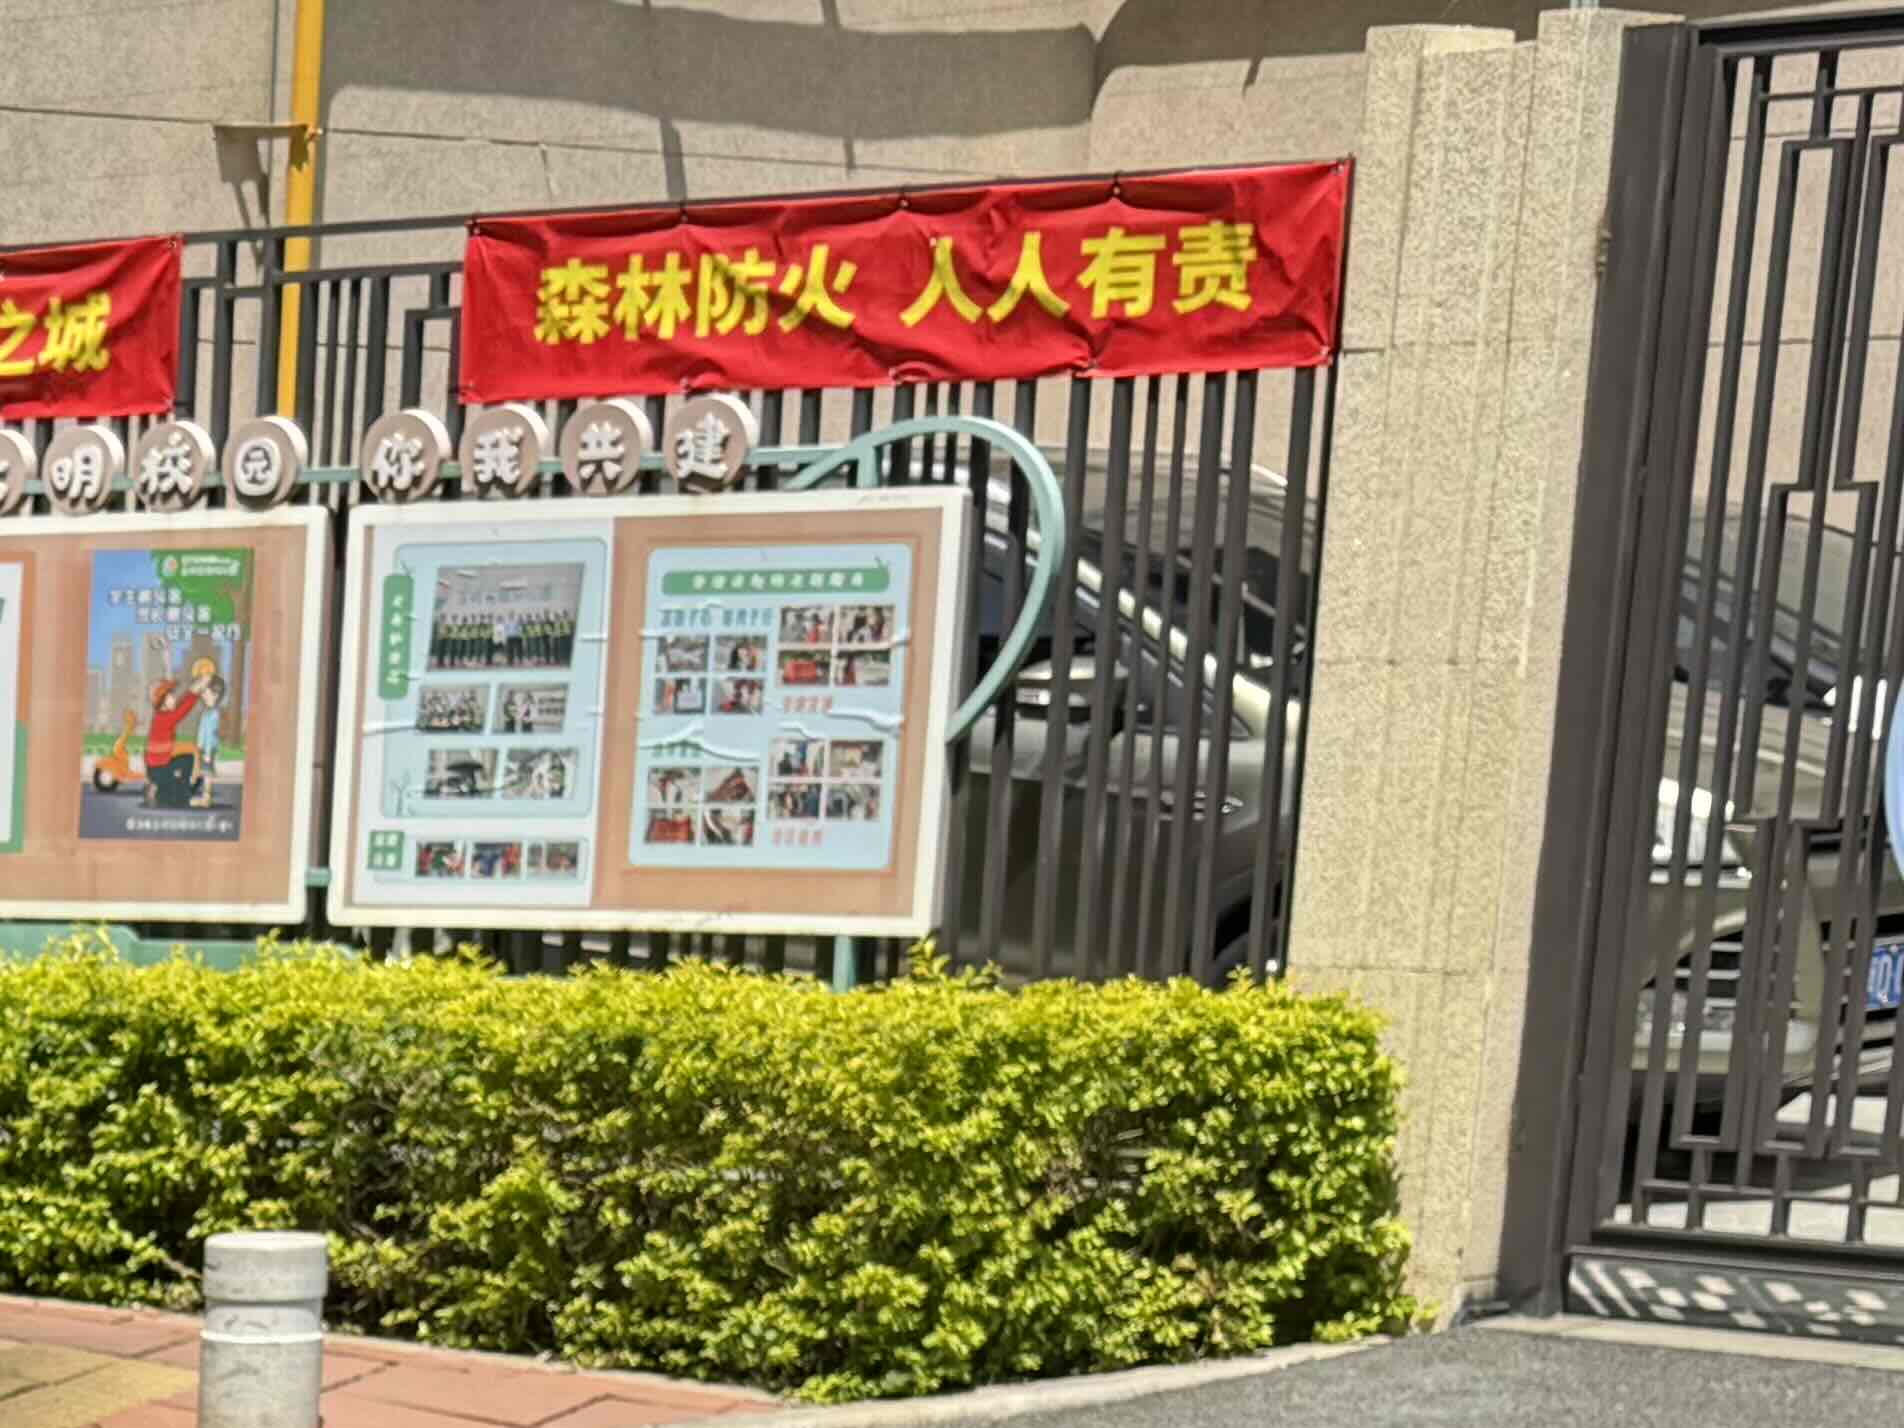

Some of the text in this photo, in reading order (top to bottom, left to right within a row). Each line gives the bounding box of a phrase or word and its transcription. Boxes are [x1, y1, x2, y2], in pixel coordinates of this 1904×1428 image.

[534, 219, 1259, 345] 森林防火 人人有责
[371, 412, 732, 492] 你我共建
